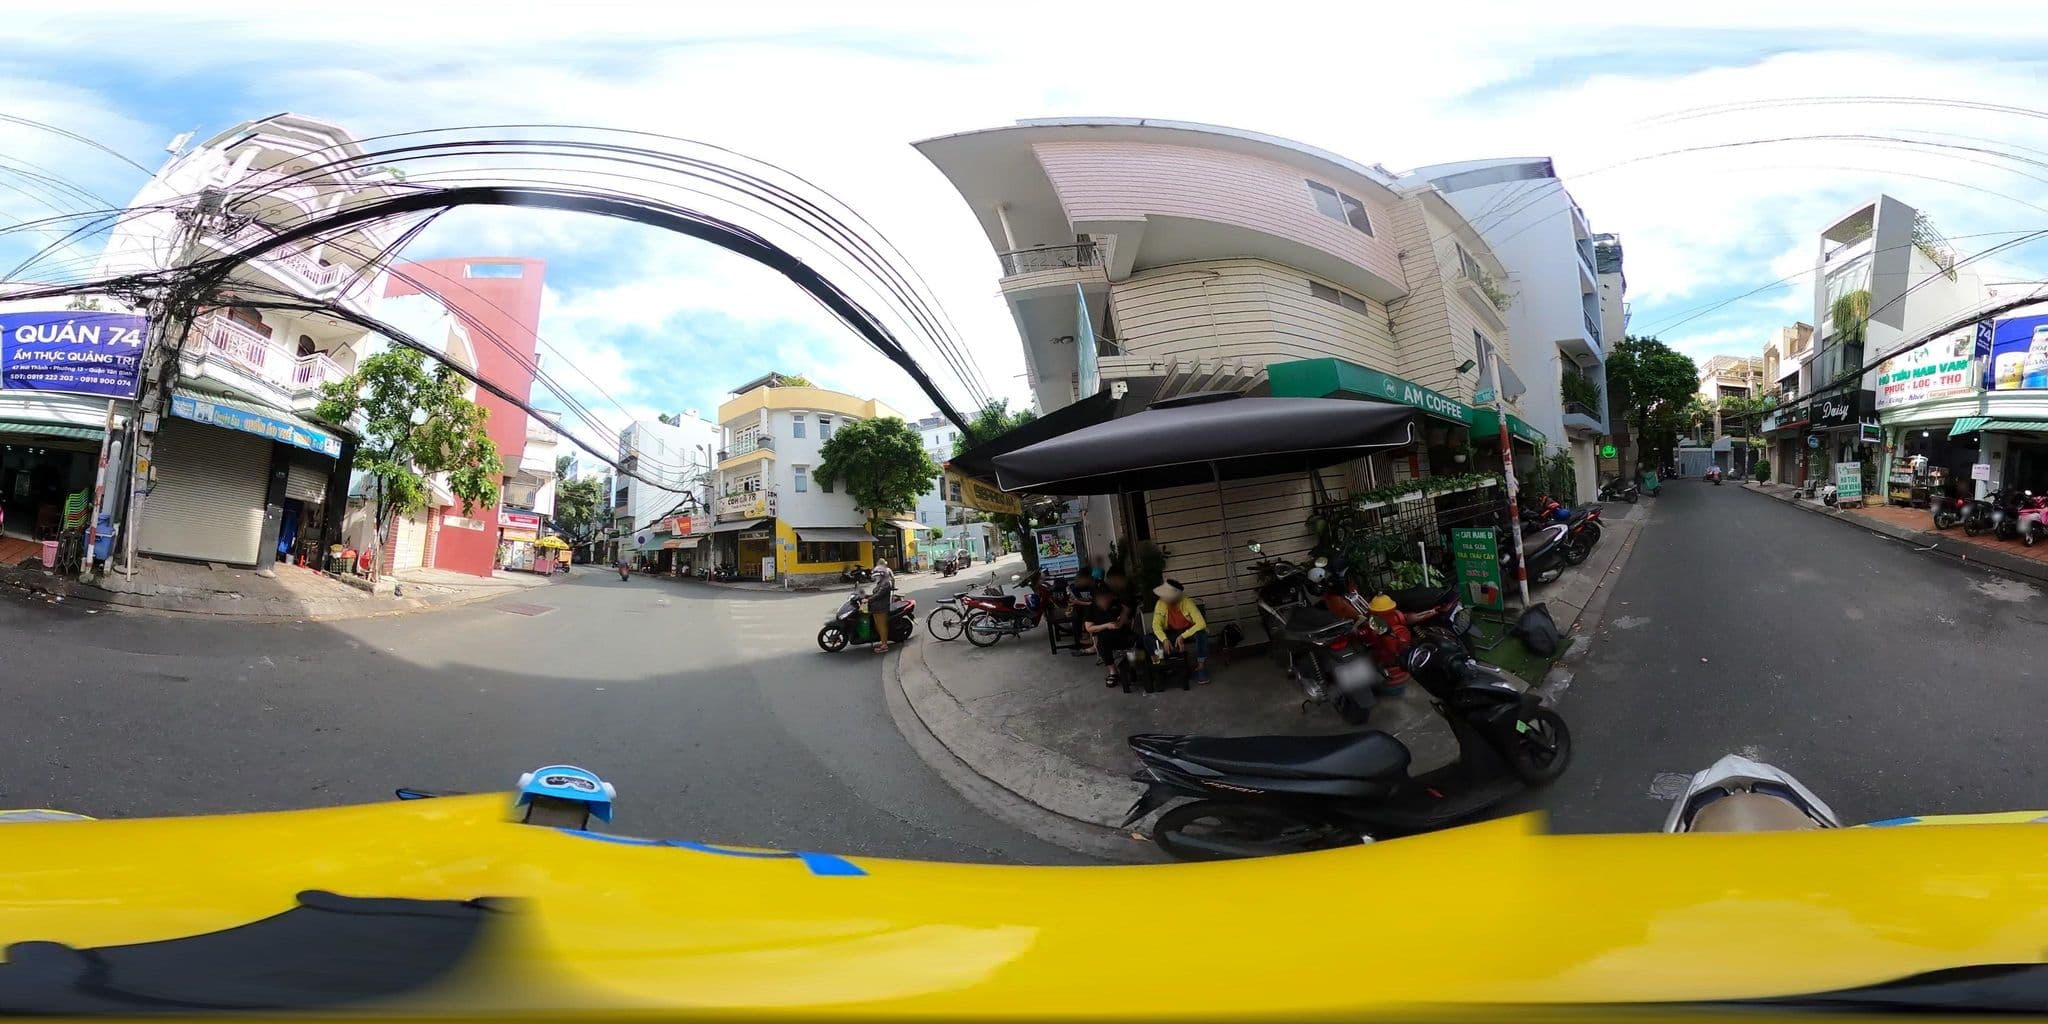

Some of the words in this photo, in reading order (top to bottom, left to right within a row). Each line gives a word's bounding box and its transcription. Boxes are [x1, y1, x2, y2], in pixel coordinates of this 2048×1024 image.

[15, 320, 101, 344] QUÁN
[107, 326, 141, 348] 74
[1979, 325, 1992, 342] 74
[33, 350, 66, 363] THỰC
[67, 350, 113, 363] QUẢNG
[1404, 385, 1424, 406] AM
[1426, 394, 1462, 418] COFFEE
[1822, 401, 1850, 421] Daisy
